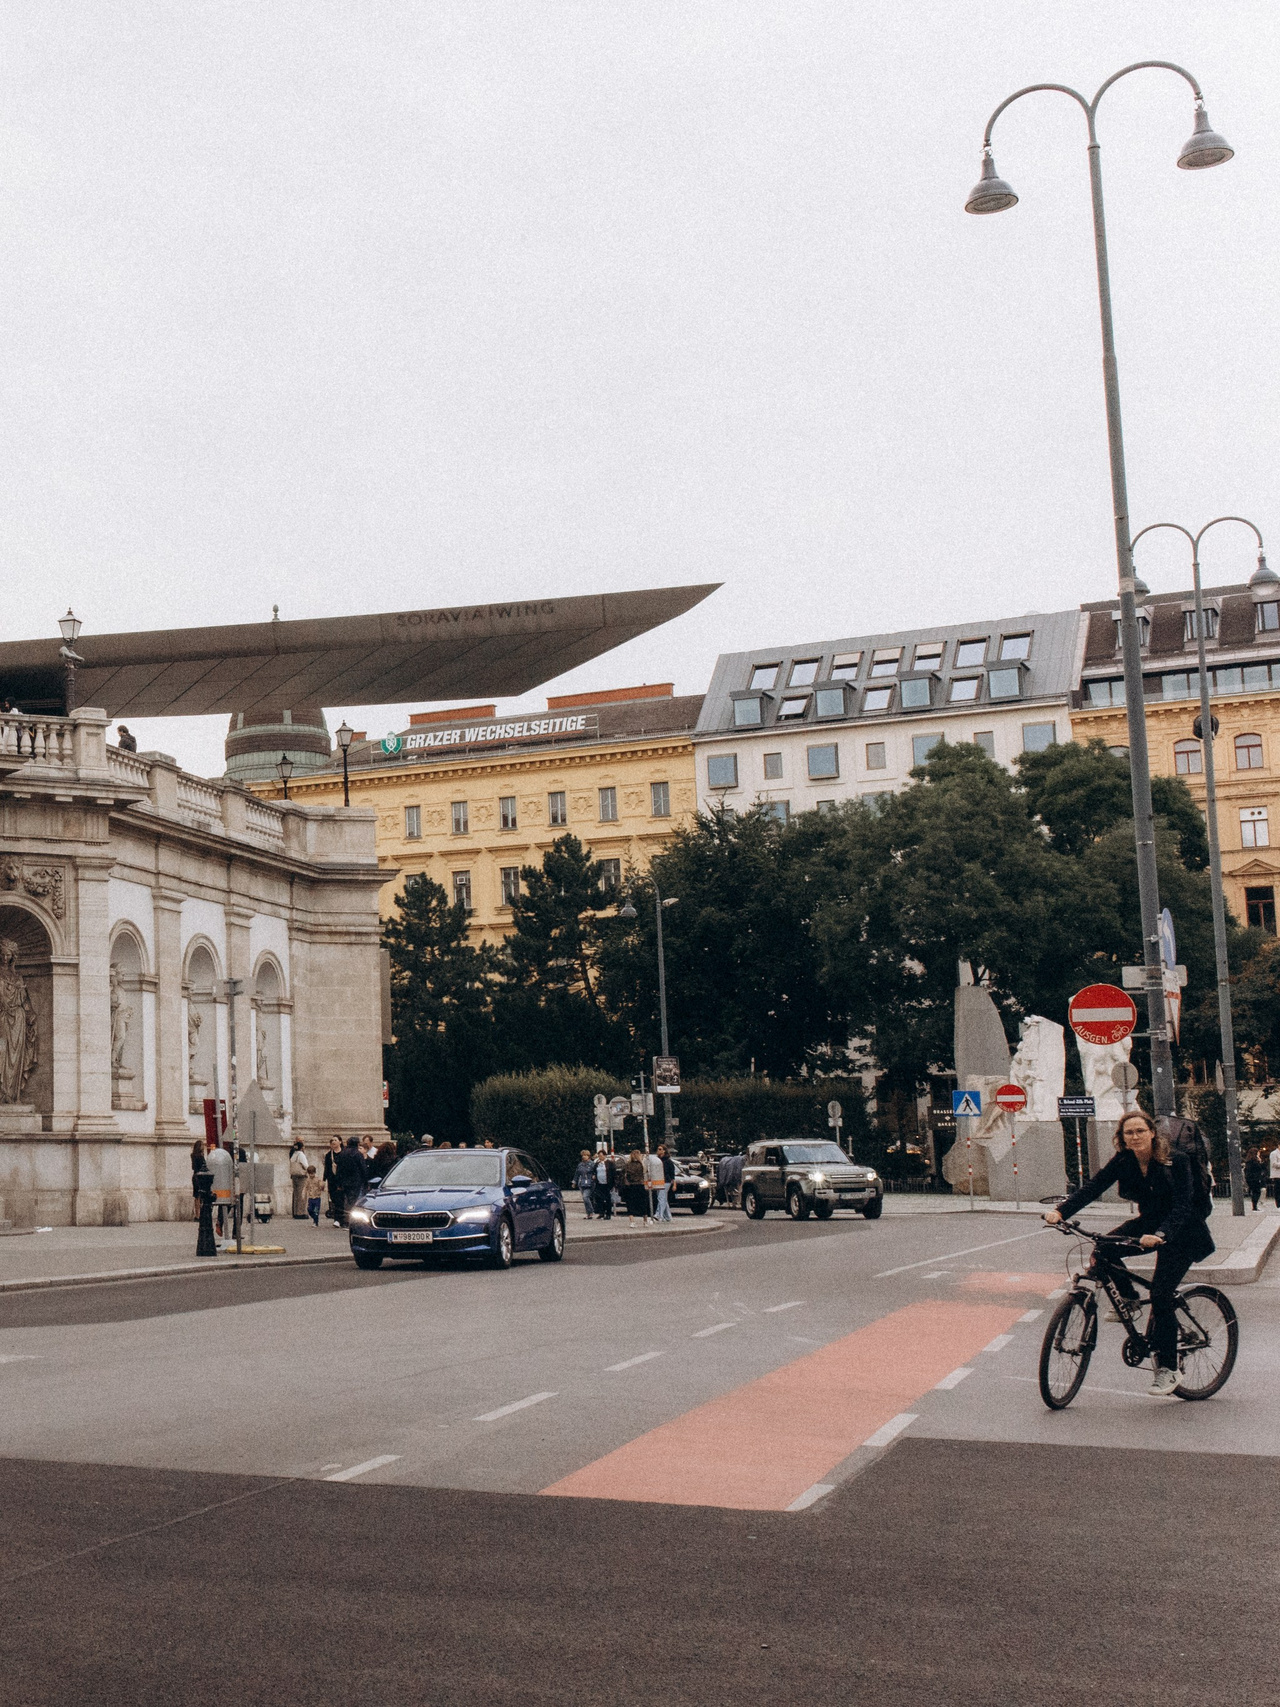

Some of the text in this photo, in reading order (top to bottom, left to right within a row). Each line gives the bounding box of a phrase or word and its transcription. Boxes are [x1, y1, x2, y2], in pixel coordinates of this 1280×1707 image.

[395, 601, 554, 627] SORAVIA WING
[406, 715, 587, 749] GRAZER WECHSELSEITIGE
[1074, 1025, 1110, 1044] AUSGEN.
